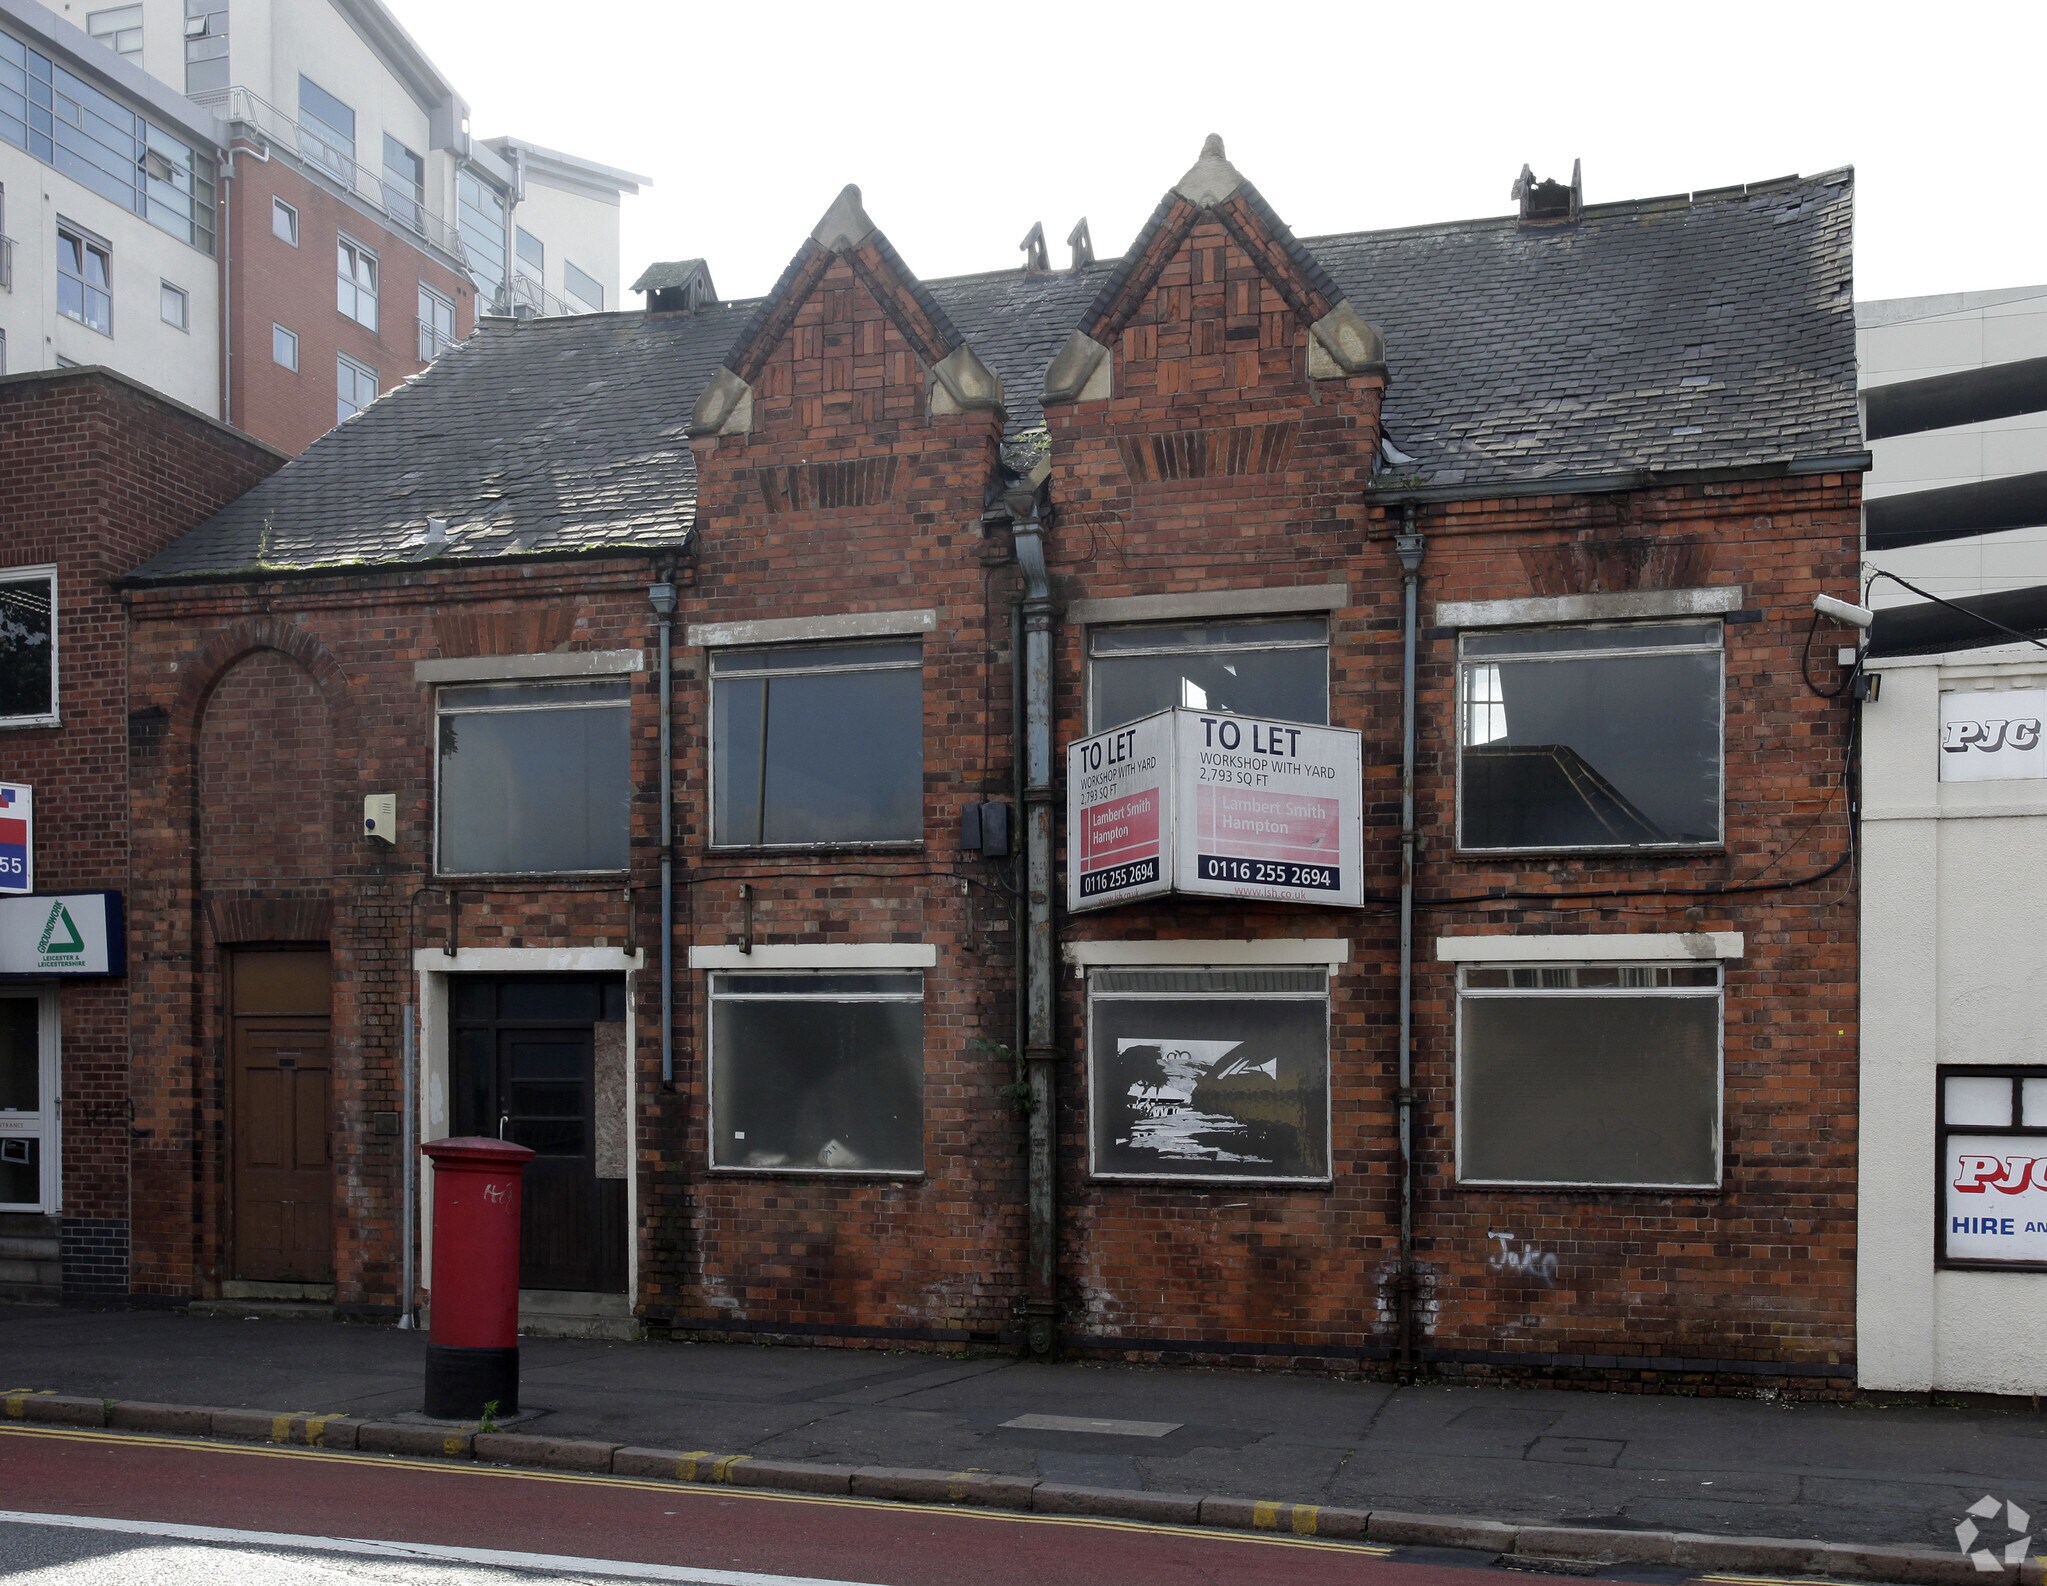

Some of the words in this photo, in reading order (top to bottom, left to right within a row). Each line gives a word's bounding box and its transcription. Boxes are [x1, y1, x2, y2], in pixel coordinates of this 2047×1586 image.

[1200, 717, 1241, 750] TO
[1252, 724, 1301, 757] LET
[1942, 718, 2041, 753] PJC
[1081, 741, 1102, 773] TO
[1108, 729, 1136, 765] LET
[1081, 768, 1117, 790] WORKSHOP
[1118, 762, 1136, 778] WITH
[1137, 756, 1156, 773] YARD
[1200, 752, 1268, 770] WORKSHOP
[1271, 761, 1301, 775] WITH
[1304, 764, 1336, 779] YARD
[1200, 767, 1232, 782] 2,793
[1236, 771, 1252, 786] SQ
[1256, 774, 1269, 786] FT
[1081, 789, 1098, 805] 2,793
[1100, 786, 1108, 799] SQ
[1110, 783, 1117, 796] FT
[1222, 795, 1281, 814] Lambert
[1286, 802, 1326, 819] Smith
[1093, 807, 1125, 827] Lambert
[1127, 798, 1151, 817] Smith
[1222, 815, 1289, 835] Hampton
[1093, 826, 1129, 845] Hampton
[1085, 873, 1107, 893] 0116
[1109, 868, 1127, 887] 255
[1129, 862, 1154, 883] 2694
[1208, 860, 1250, 879] 0116
[1255, 864, 1286, 882] 255
[1291, 867, 1331, 886] 2694
[1234, 886, 1307, 900] www.lsh.co.uk
[37, 899, 63, 954] GROUNDWORK
[1952, 1216, 2015, 1236] HIRE
